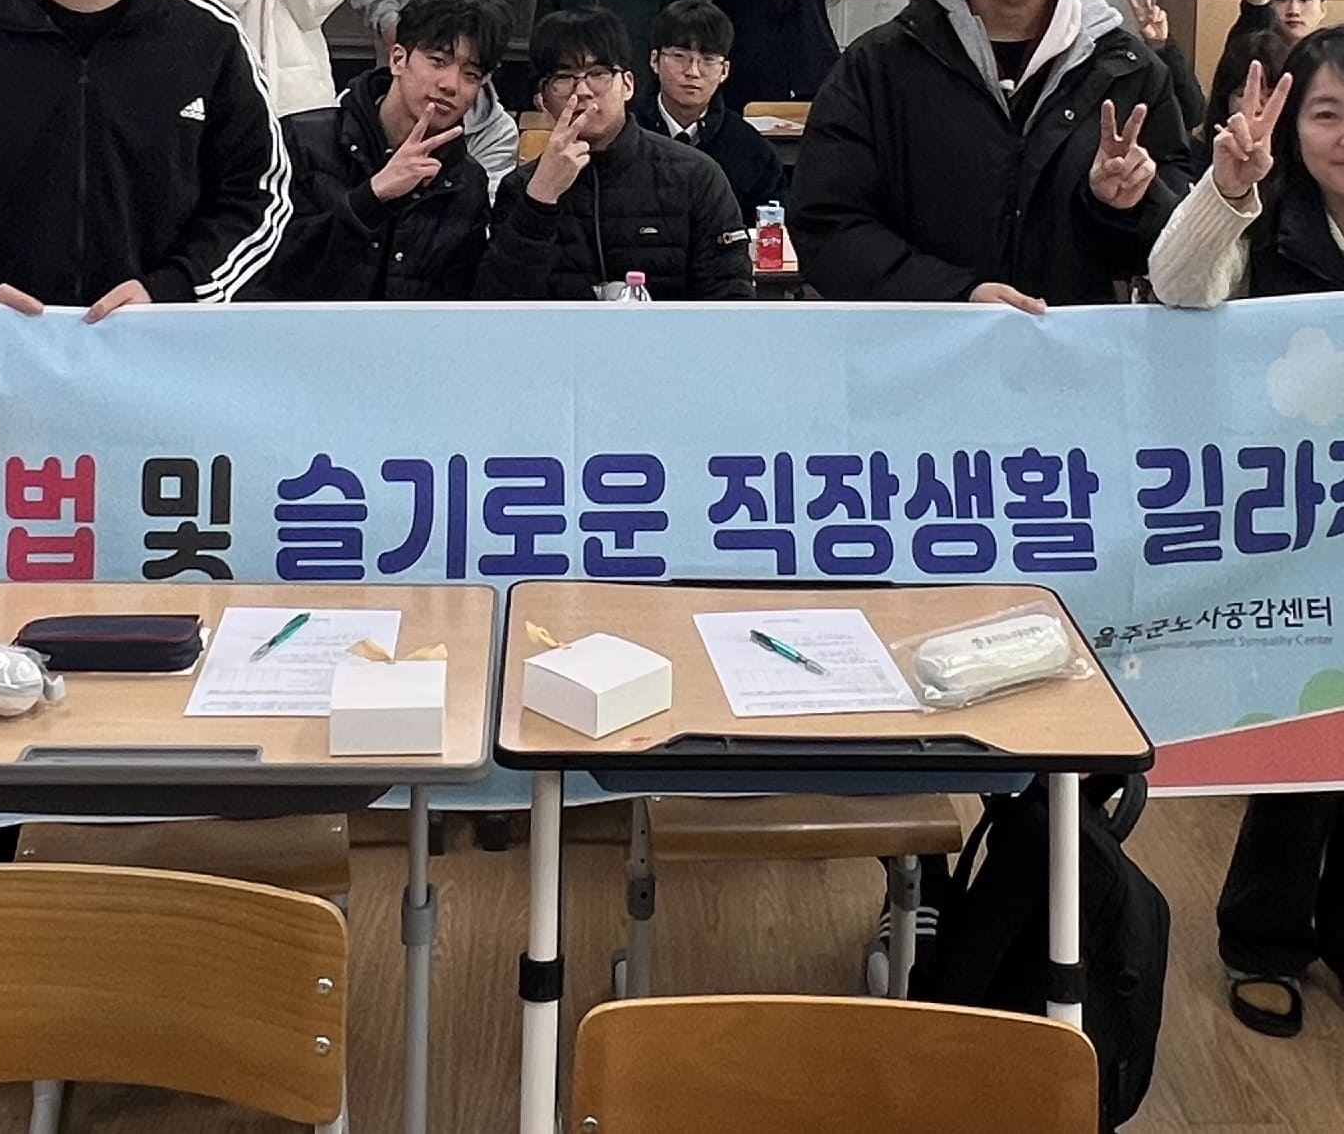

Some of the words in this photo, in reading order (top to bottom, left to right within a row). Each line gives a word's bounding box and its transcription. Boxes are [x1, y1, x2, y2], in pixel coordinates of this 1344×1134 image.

[140, 454, 234, 581] 및
[272, 452, 670, 580] 슬기로운
[706, 446, 1101, 576] 직장생활
